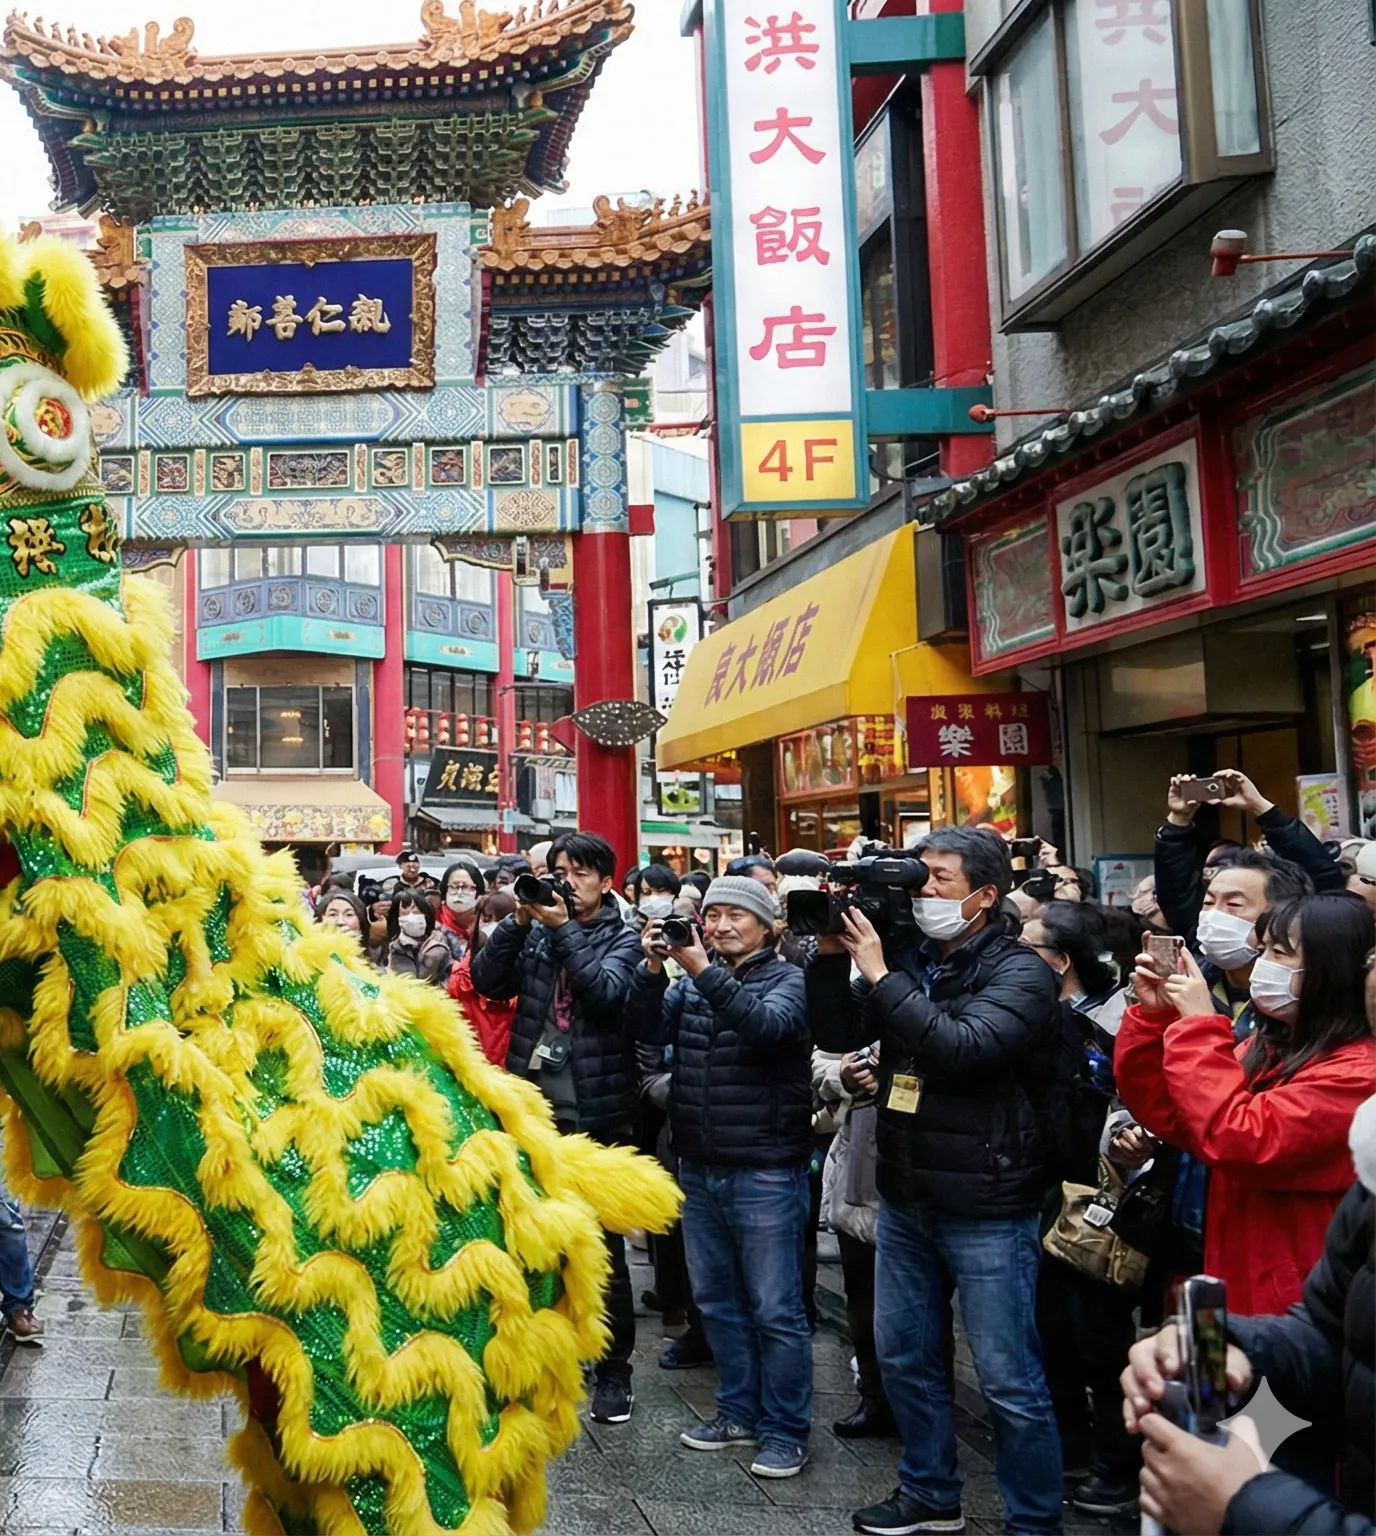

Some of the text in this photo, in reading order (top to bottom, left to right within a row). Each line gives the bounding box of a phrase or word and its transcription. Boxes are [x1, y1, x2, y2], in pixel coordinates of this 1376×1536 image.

[744, 11, 837, 369] 洪大飯店
[758, 438, 838, 482] 4F
